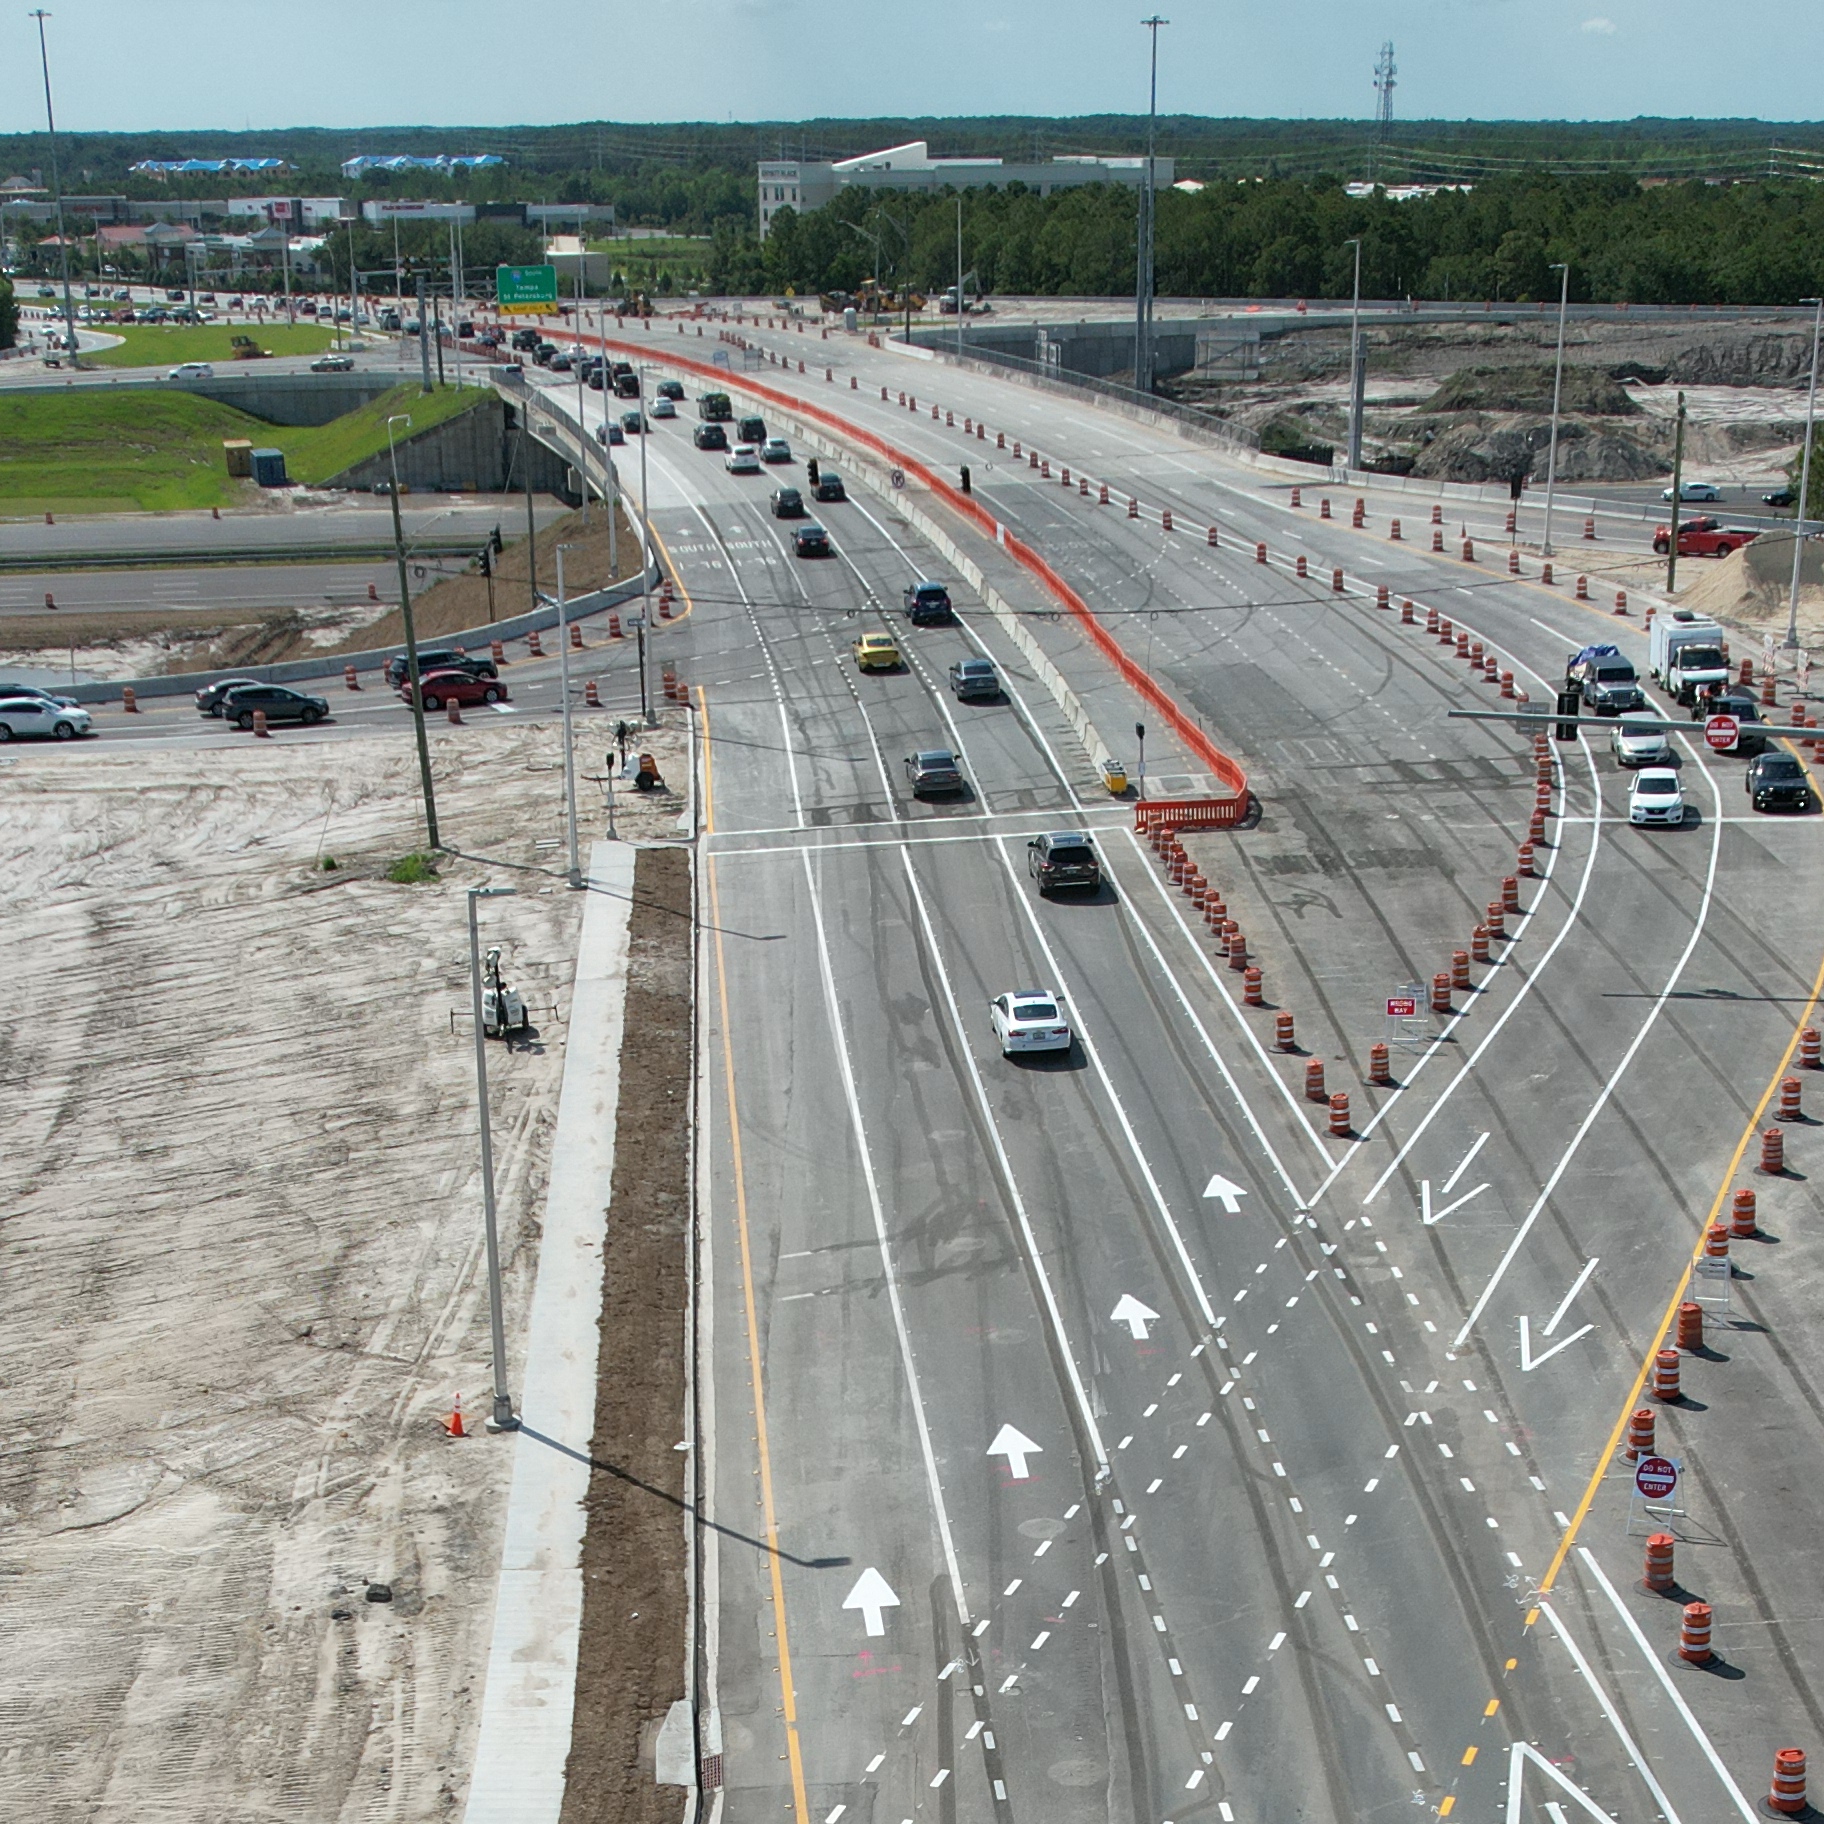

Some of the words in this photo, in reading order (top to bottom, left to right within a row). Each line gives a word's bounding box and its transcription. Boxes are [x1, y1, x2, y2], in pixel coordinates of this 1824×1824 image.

[668, 543, 717, 553] SOUTH
[725, 540, 773, 550] SOUTH
[1643, 1464, 1653, 1472] DO
